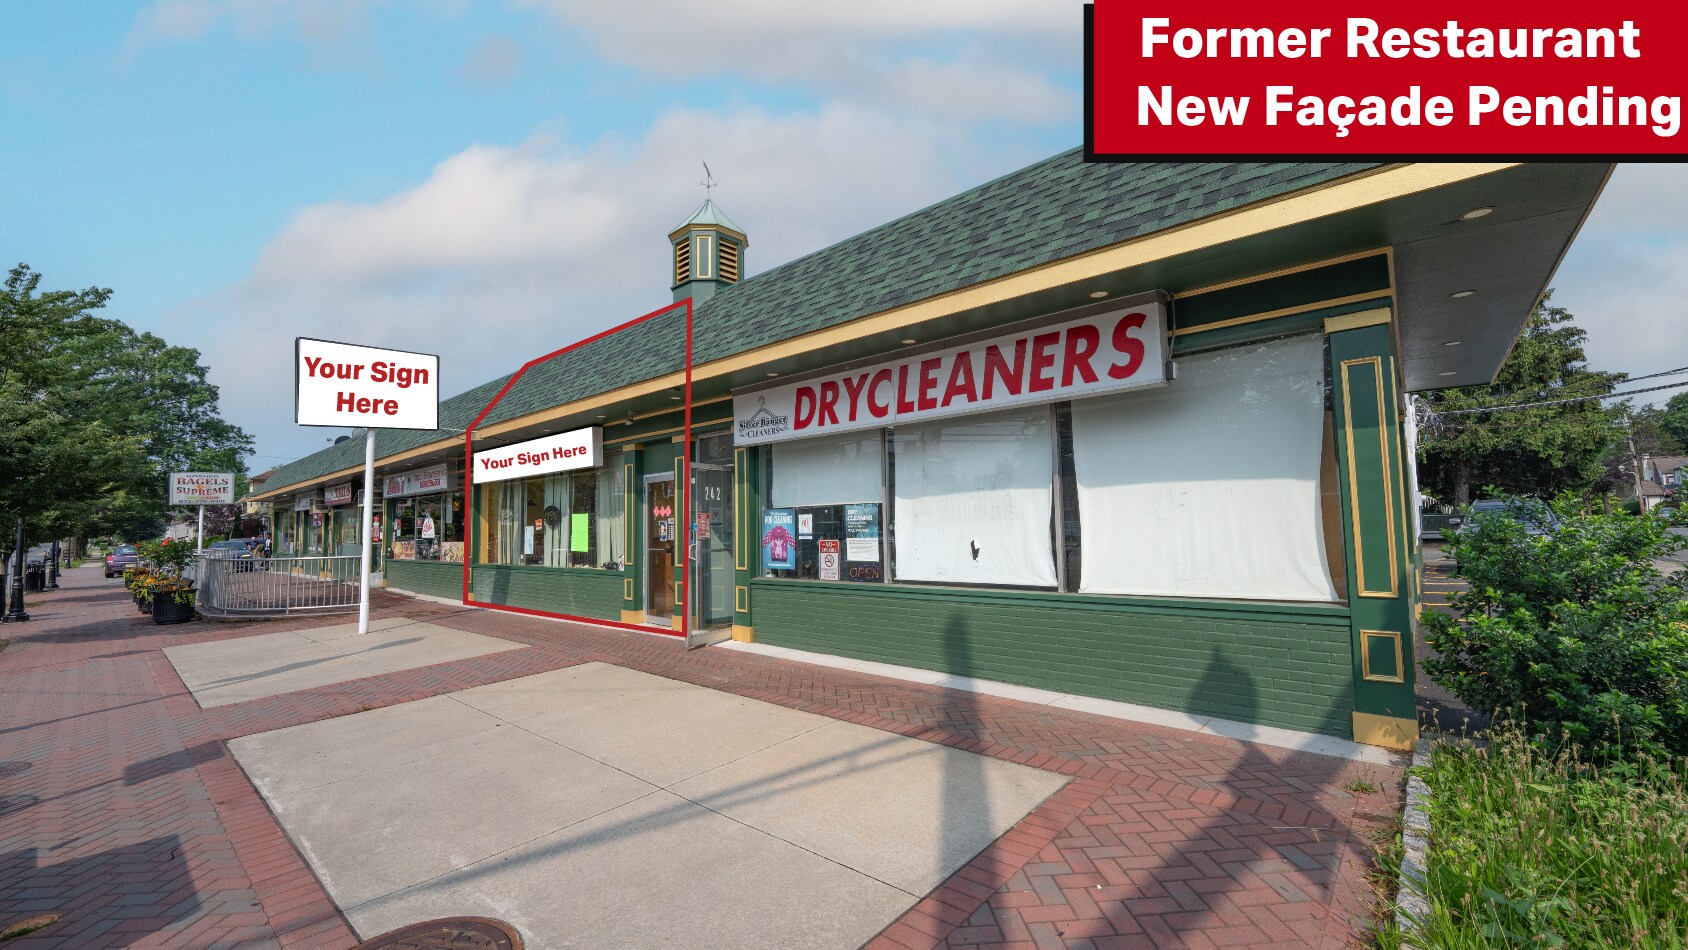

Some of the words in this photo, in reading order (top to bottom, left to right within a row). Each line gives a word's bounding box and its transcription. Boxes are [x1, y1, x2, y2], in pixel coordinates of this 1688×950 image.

[304, 356, 365, 380] Your
[370, 361, 429, 388] Sign
[793, 312, 1147, 431] DRYCLEANERS
[336, 391, 399, 416] Here
[747, 427, 780, 438] CLEANERS
[481, 457, 514, 470] Your
[517, 451, 550, 466] Sign
[552, 446, 587, 460] Here
[177, 477, 229, 485] BAGELS
[176, 486, 229, 496] SUPREME
[849, 567, 880, 579] OPEN
